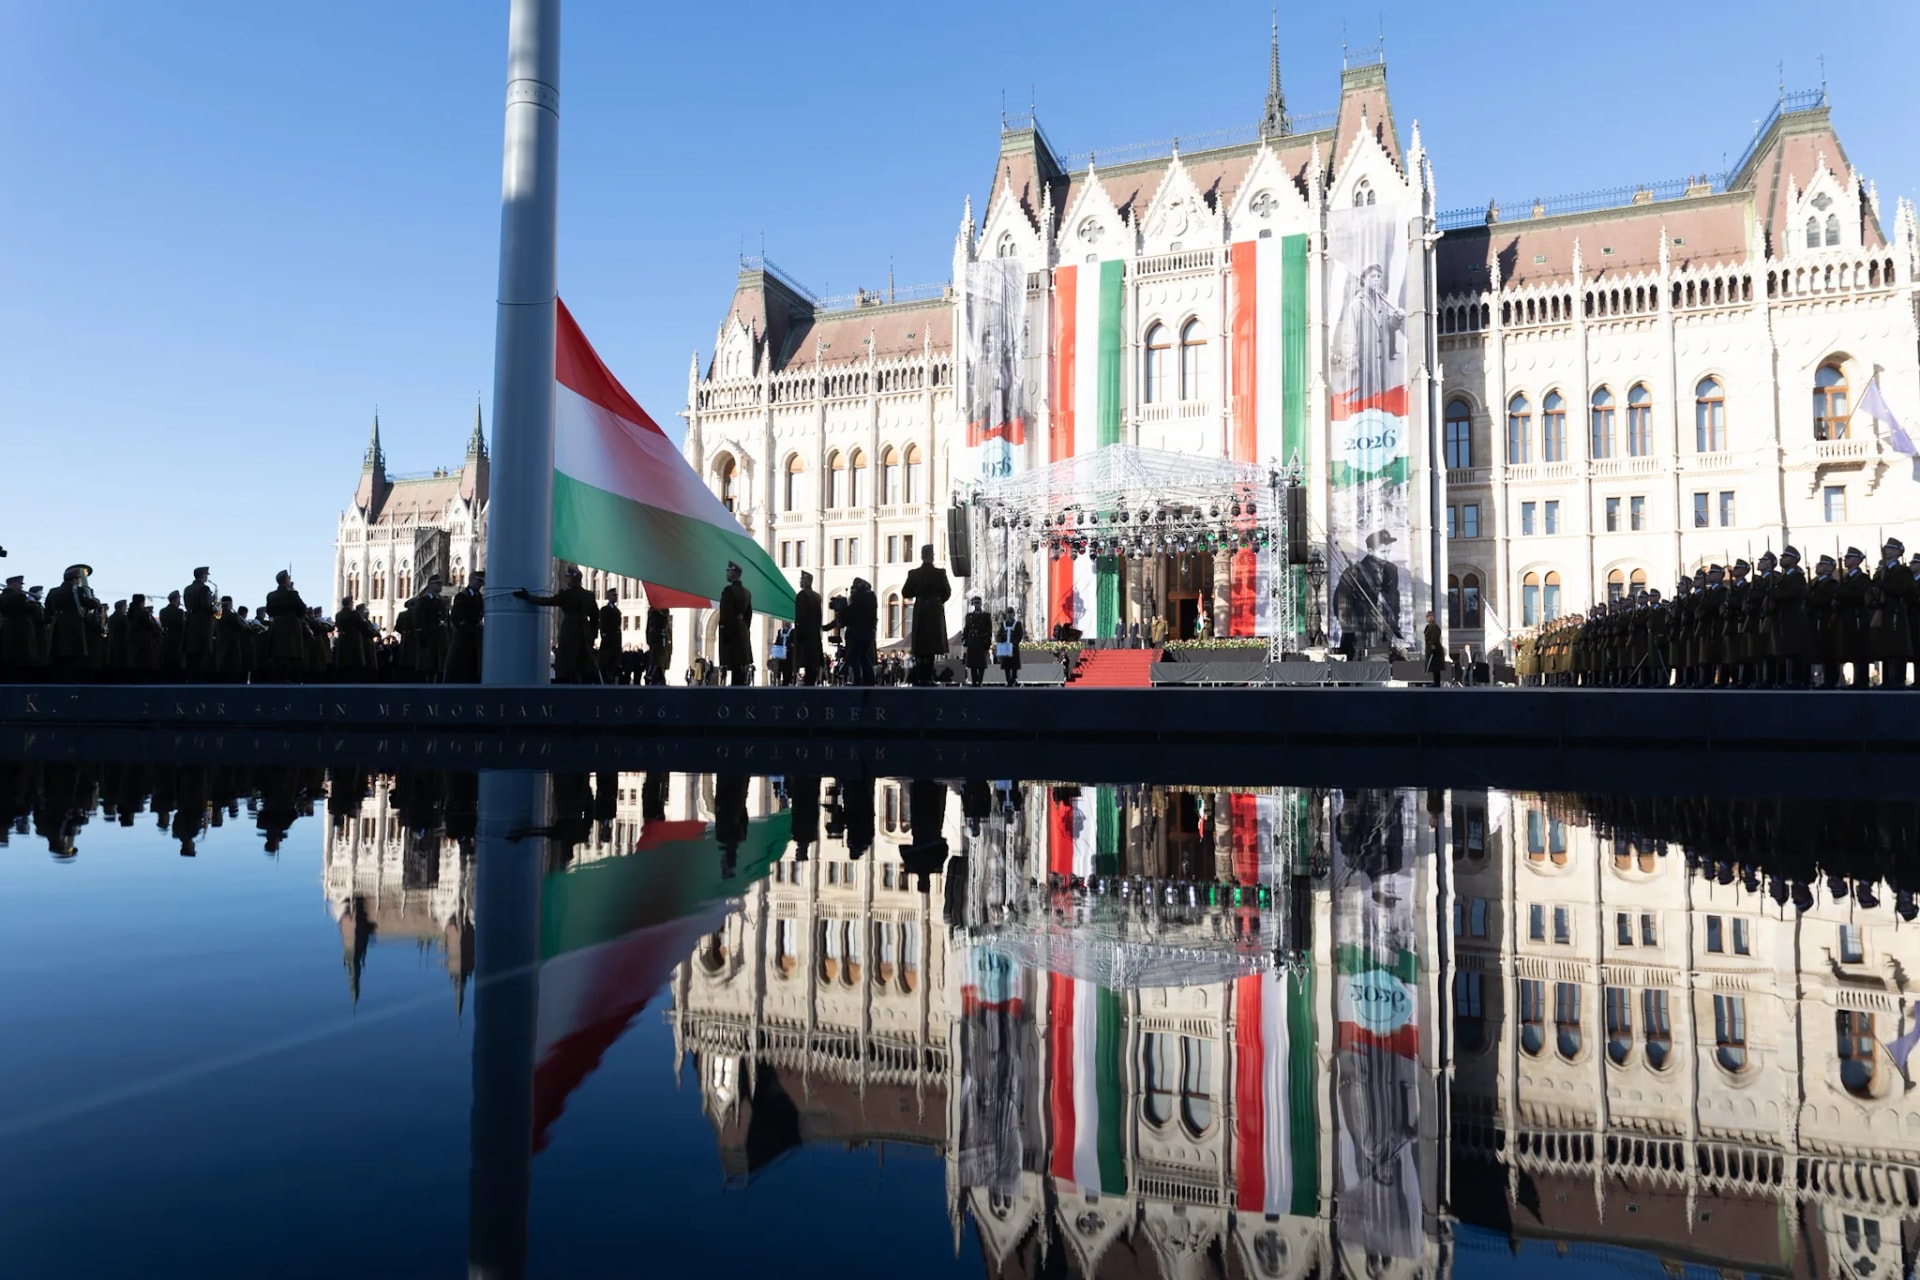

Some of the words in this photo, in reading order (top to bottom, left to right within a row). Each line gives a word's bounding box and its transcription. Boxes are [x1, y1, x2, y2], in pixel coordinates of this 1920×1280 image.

[1344, 429, 1397, 450] 2026
[982, 457, 1011, 478] 1956
[175, 702, 226, 715] KOR
[318, 703, 347, 716] IN
[377, 703, 554, 718] MEMORIAM
[595, 705, 679, 719] 1956.
[716, 703, 886, 721] OKTÓBER
[935, 707, 981, 721] 25.
